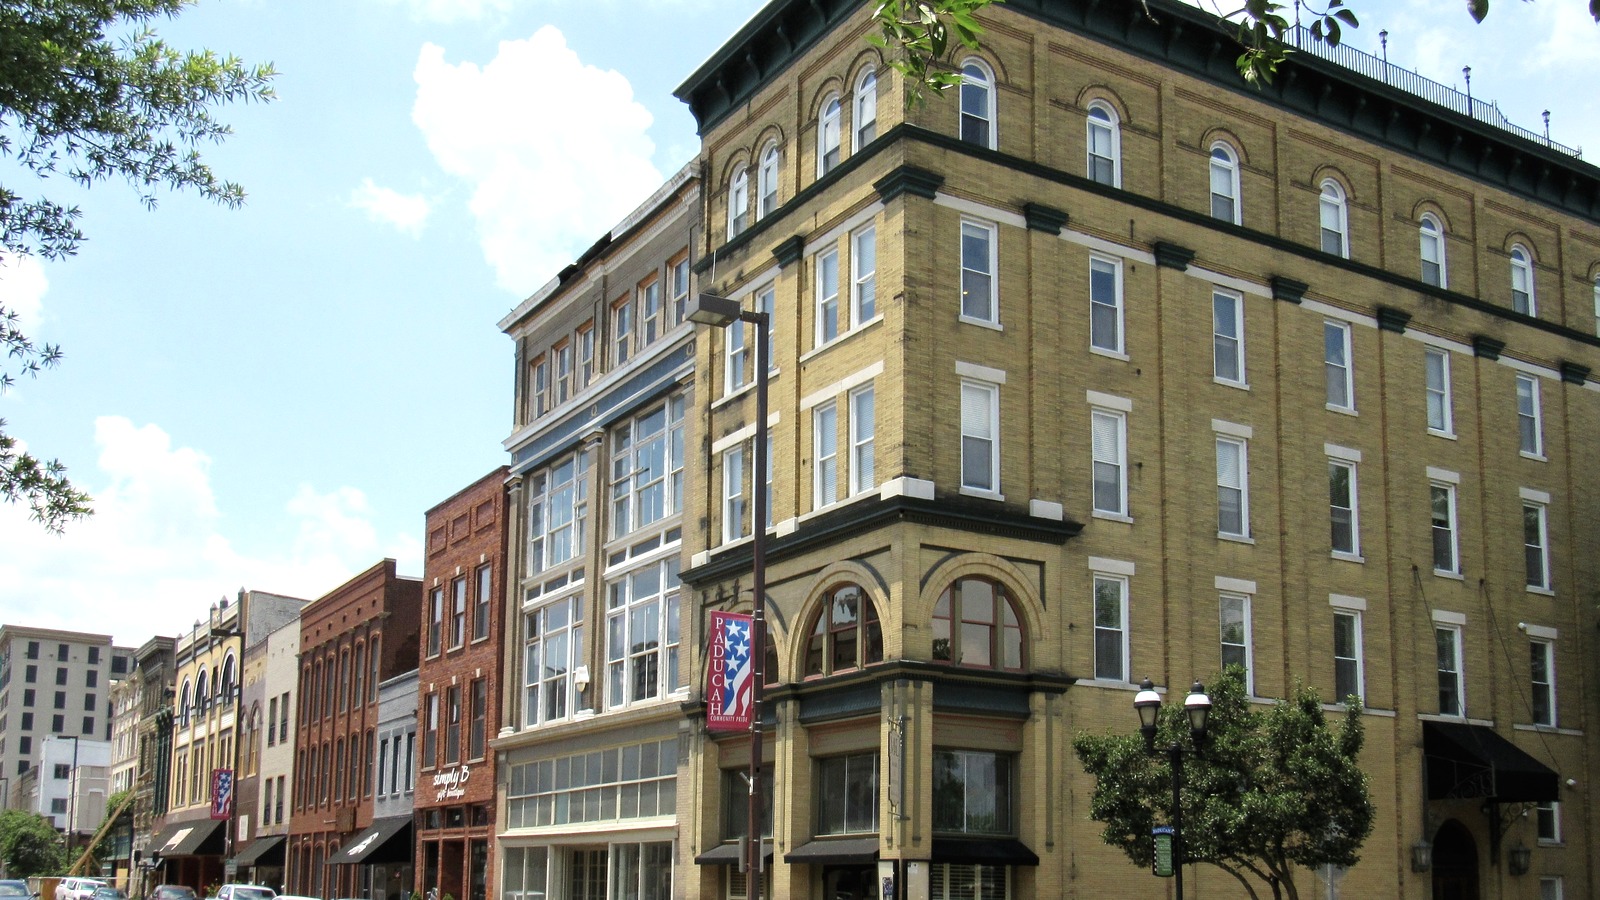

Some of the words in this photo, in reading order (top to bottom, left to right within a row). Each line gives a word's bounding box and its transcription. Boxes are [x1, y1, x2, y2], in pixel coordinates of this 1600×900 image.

[710, 617, 724, 716] PADUCAH
[433, 768, 460, 790] simply
[461, 765, 470, 782] B
